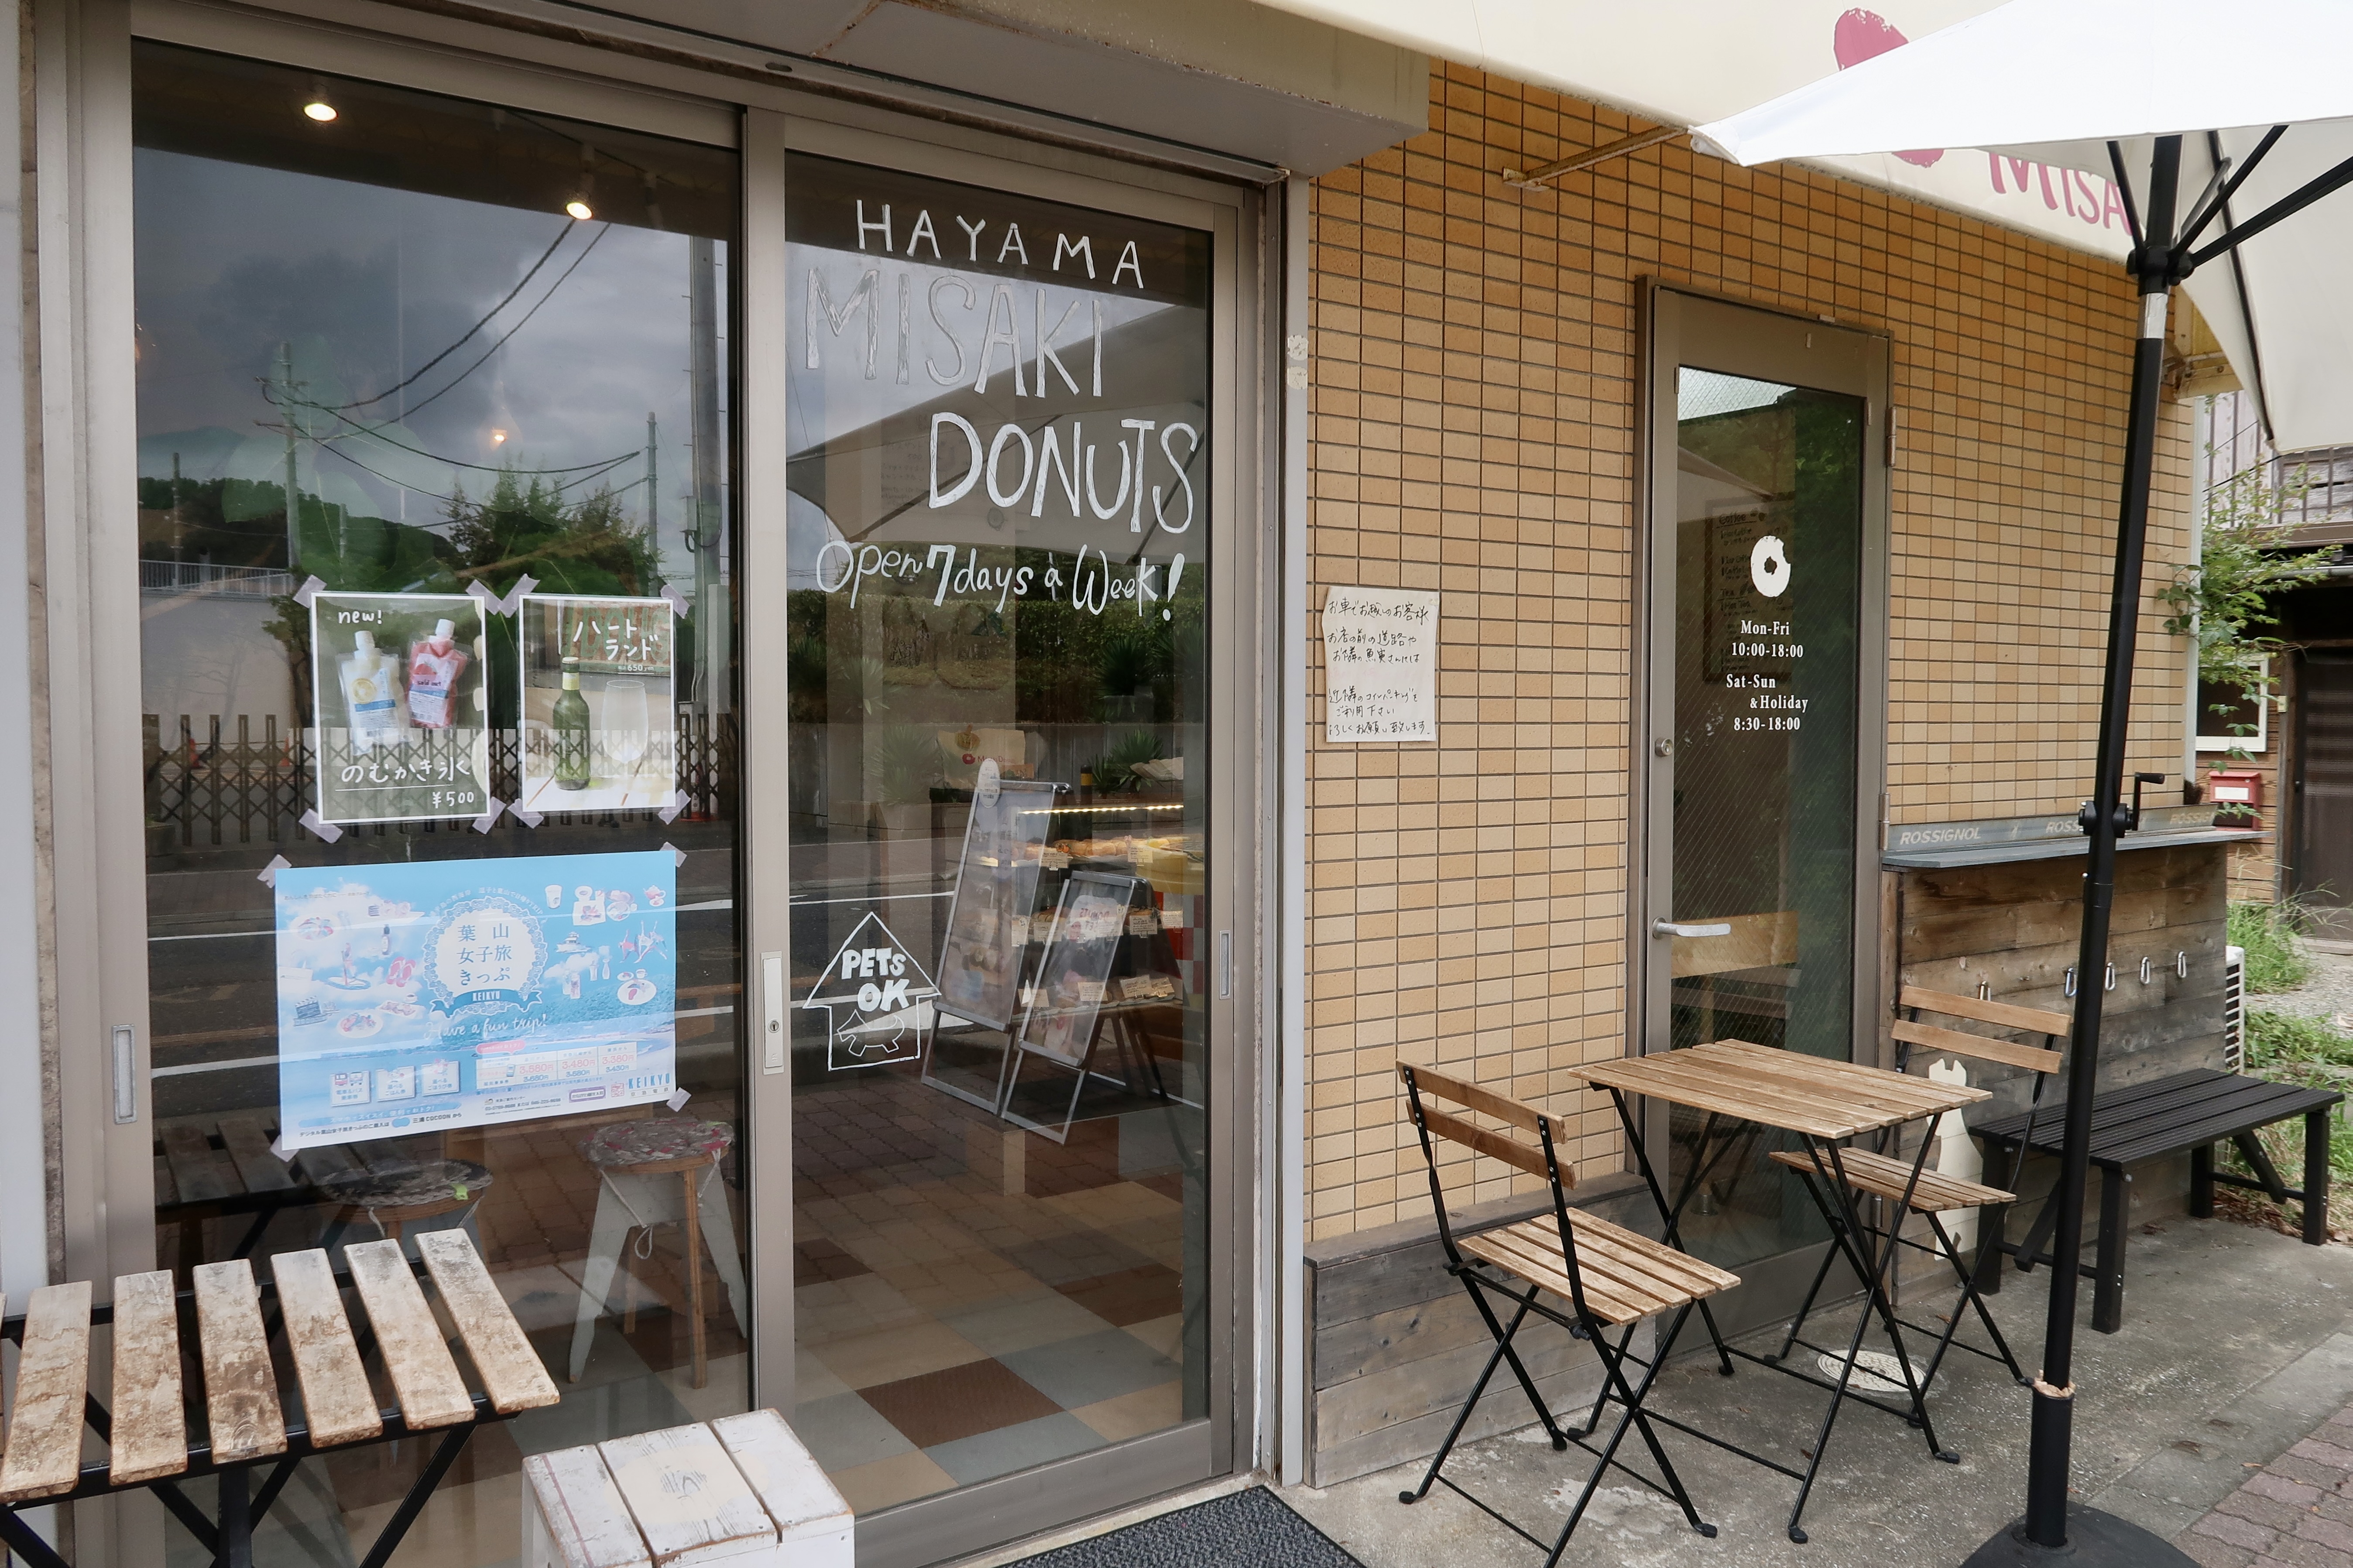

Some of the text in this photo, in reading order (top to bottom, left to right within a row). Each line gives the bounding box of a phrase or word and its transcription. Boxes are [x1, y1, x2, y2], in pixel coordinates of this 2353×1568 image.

[856, 199, 1144, 288] HAYAMA
[806, 267, 1102, 398] MISAKI
[929, 411, 1197, 534] DONUTS
[816, 541, 923, 609] Open
[1045, 567, 1063, 588] a
[1072, 544, 1186, 621] Week!
[338, 609, 383, 625] new!
[573, 619, 637, 642] ハート
[1327, 627, 1417, 646] お店の前の道路や
[1741, 620, 1790, 635] Mon-Fri
[606, 634, 659, 661] ランド
[1732, 643, 1803, 657] 10:00-18:00
[1726, 674, 1776, 688] Sat-Sun
[1336, 705, 1394, 718] ご利用下さい
[1733, 717, 1801, 731] 8:30-18:00
[341, 756, 470, 784] のむかき氷
[432, 791, 475, 809] ¥500
[1900, 827, 1981, 846] ROSSIGNOL
[2046, 821, 2080, 834] ROSS
[457, 923, 509, 942] 葉山
[456, 945, 512, 965] 女子旅
[841, 947, 906, 979] PETS
[460, 967, 510, 986] きっぷ
[472, 990, 501, 1002] KEIKYU
[858, 978, 910, 1012] OK
[480, 1018, 509, 1040] fun
[512, 1013, 546, 1033] trip!
[562, 1059, 595, 1069] 3,480円
[602, 1054, 634, 1065] 3,380円
[628, 1073, 670, 1089] KEIKYU
